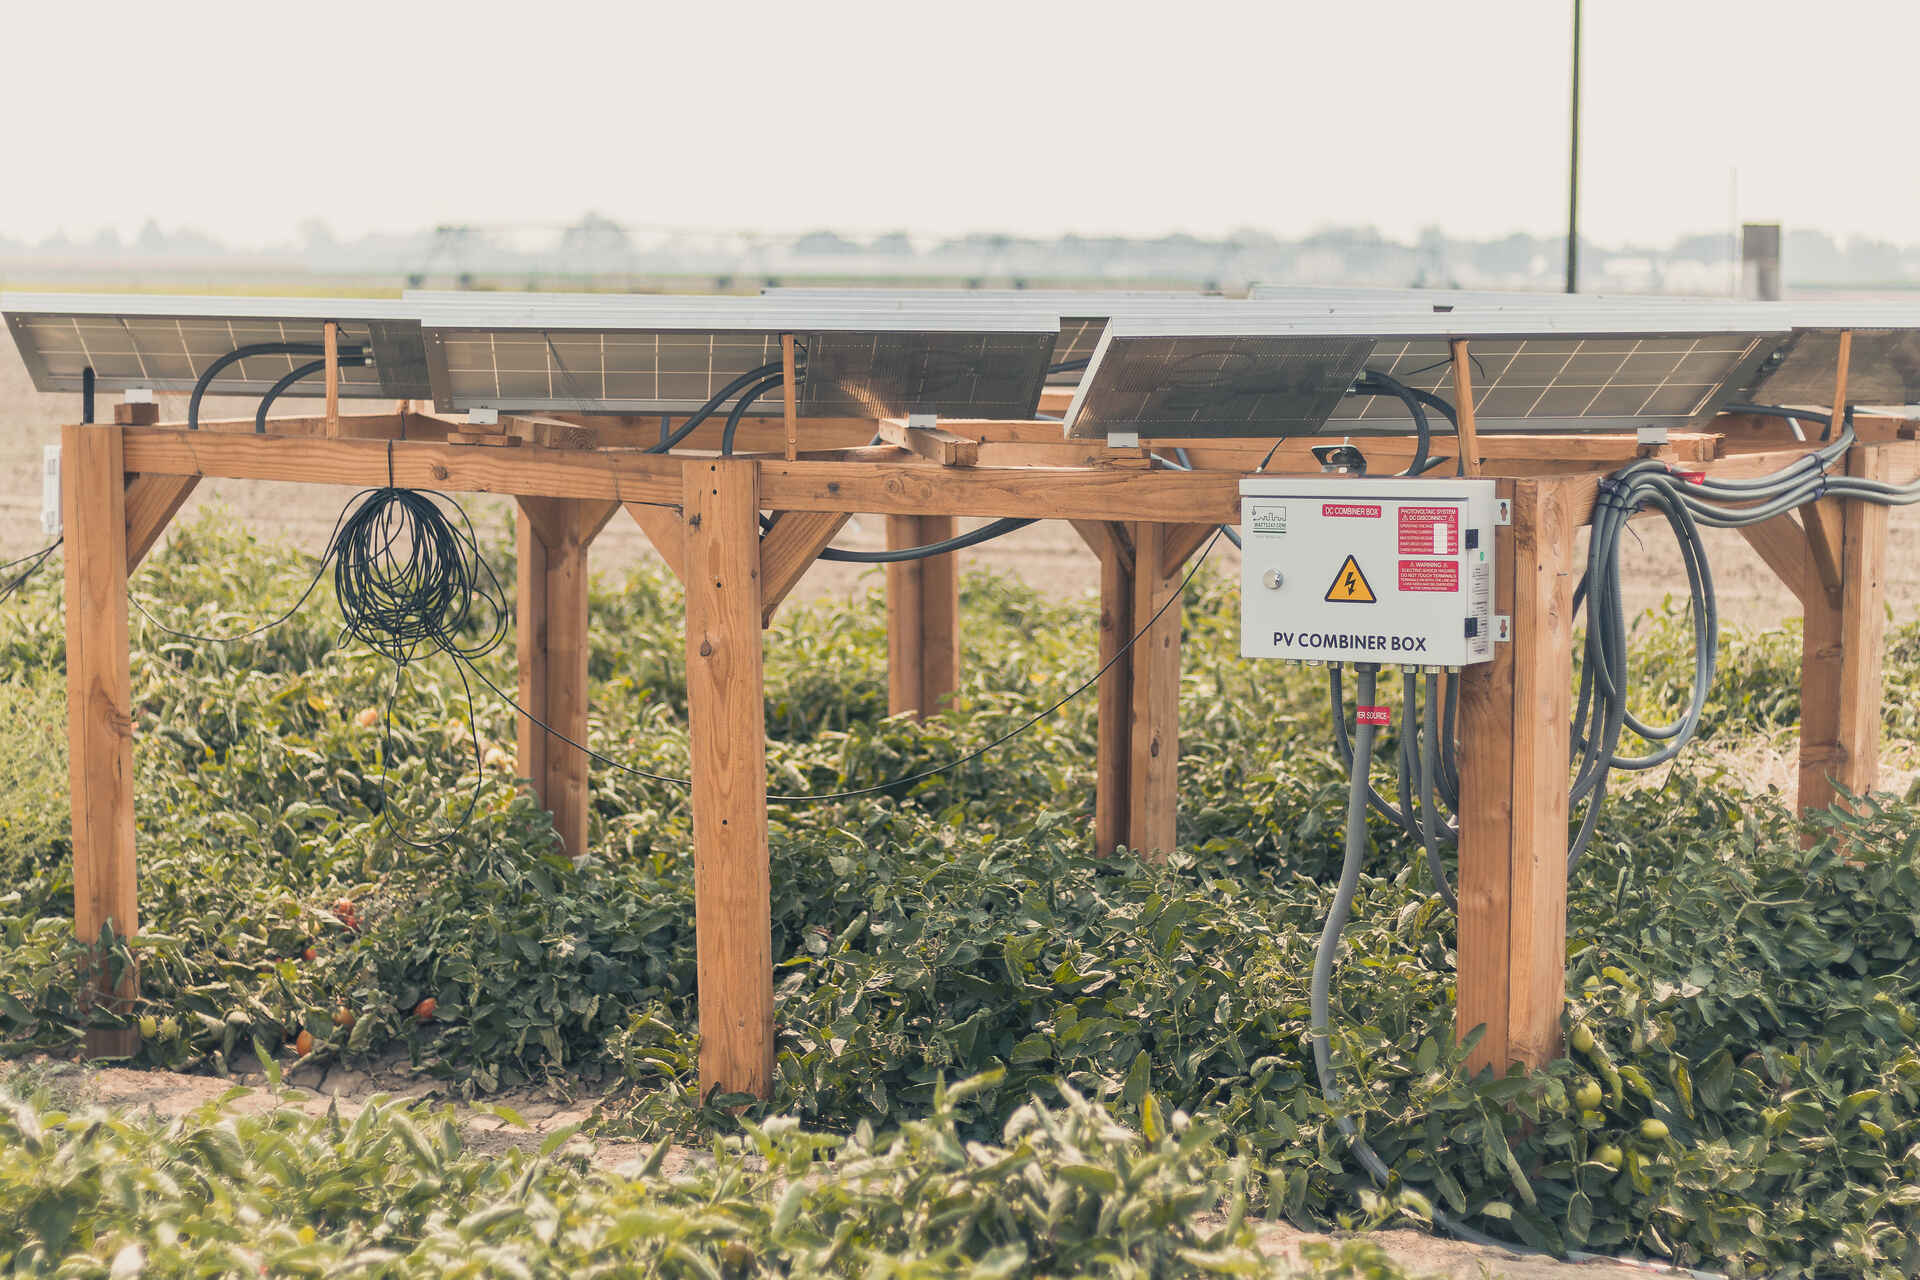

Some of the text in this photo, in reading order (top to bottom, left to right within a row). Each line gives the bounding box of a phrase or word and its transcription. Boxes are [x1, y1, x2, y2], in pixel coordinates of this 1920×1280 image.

[1273, 632, 1427, 652] PV COMBINER BOX
